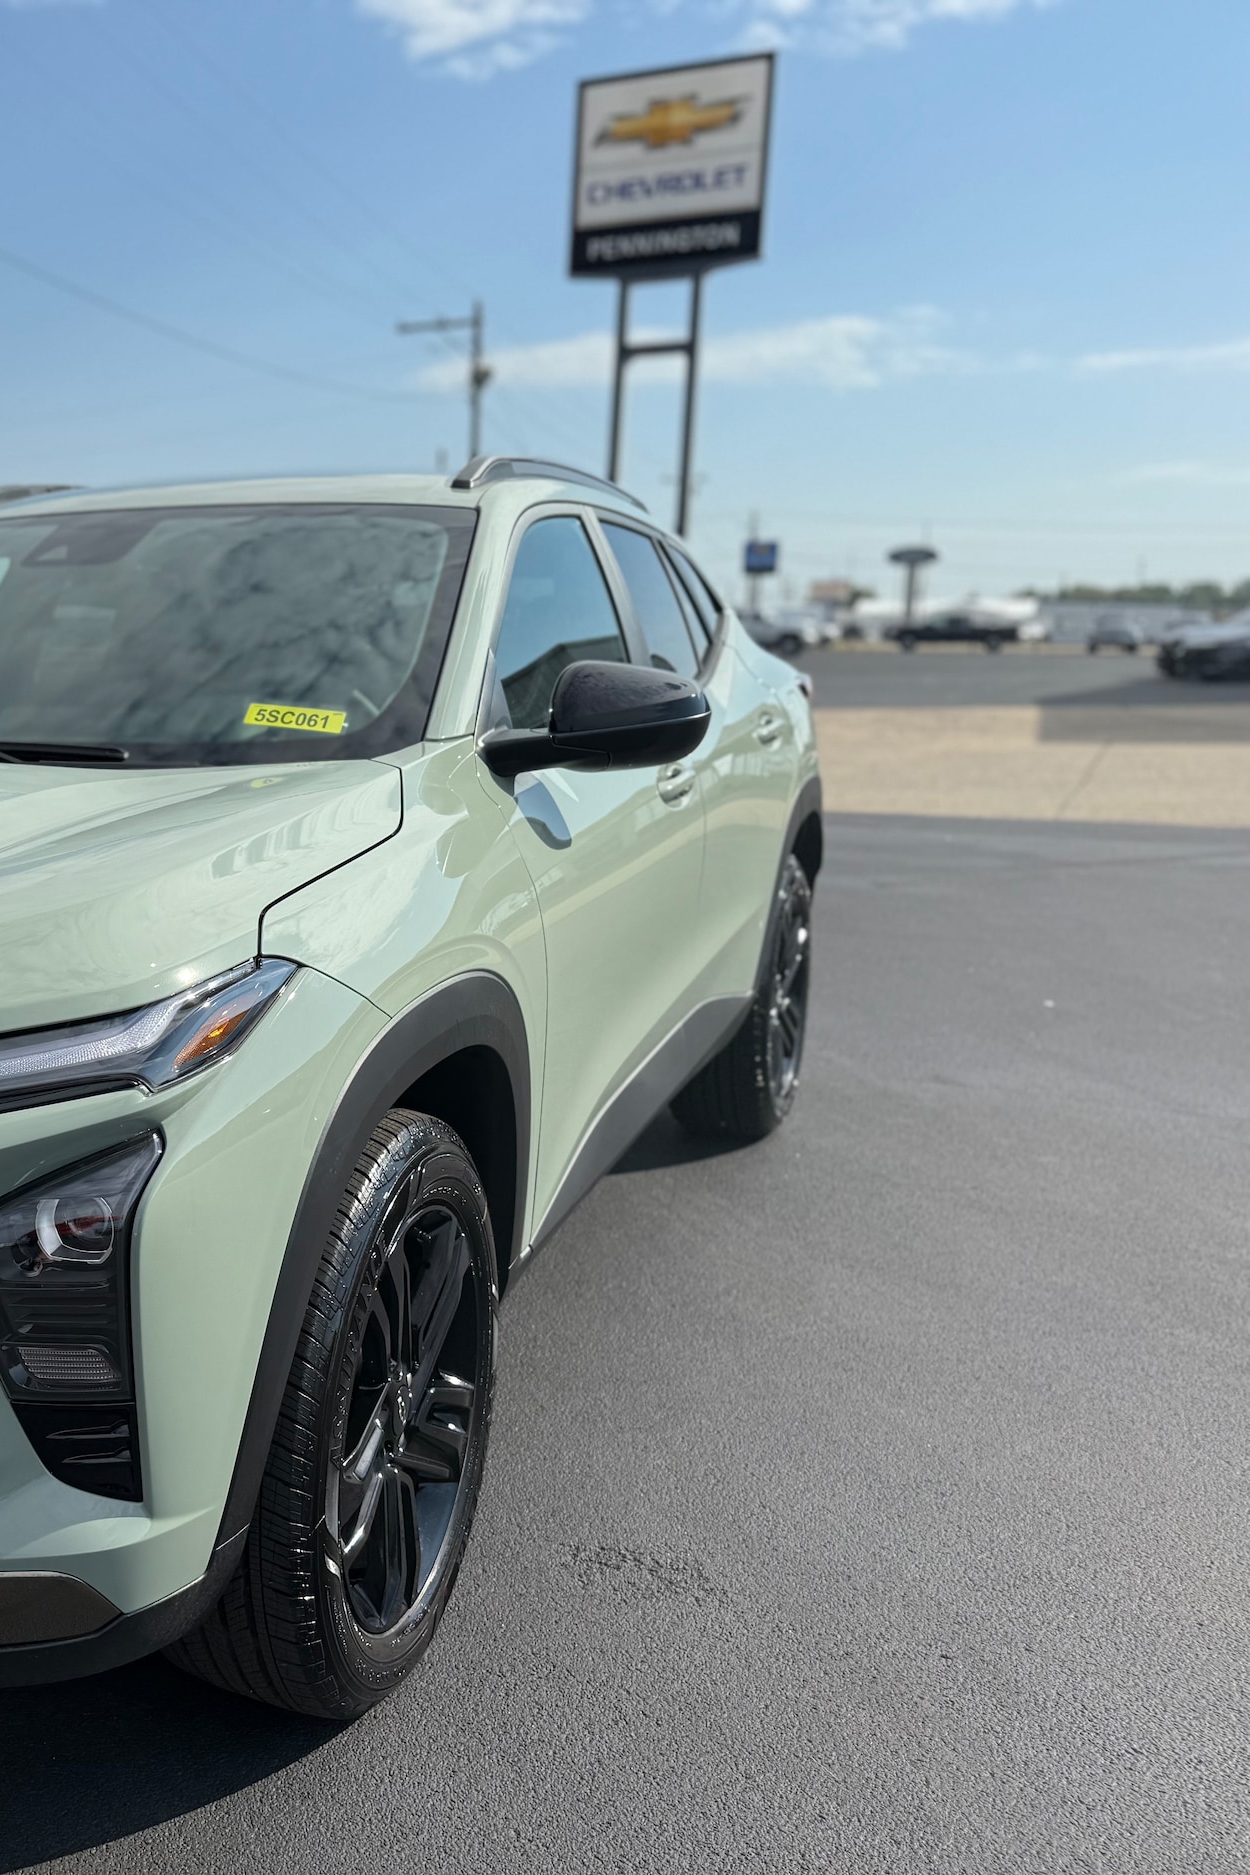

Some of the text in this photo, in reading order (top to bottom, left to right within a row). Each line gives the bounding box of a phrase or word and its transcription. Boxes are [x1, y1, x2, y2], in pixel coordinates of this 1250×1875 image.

[586, 164, 746, 206] CHEVROLET
[585, 222, 741, 262] PENNINGTON
[254, 708, 330, 729] 5SC061
